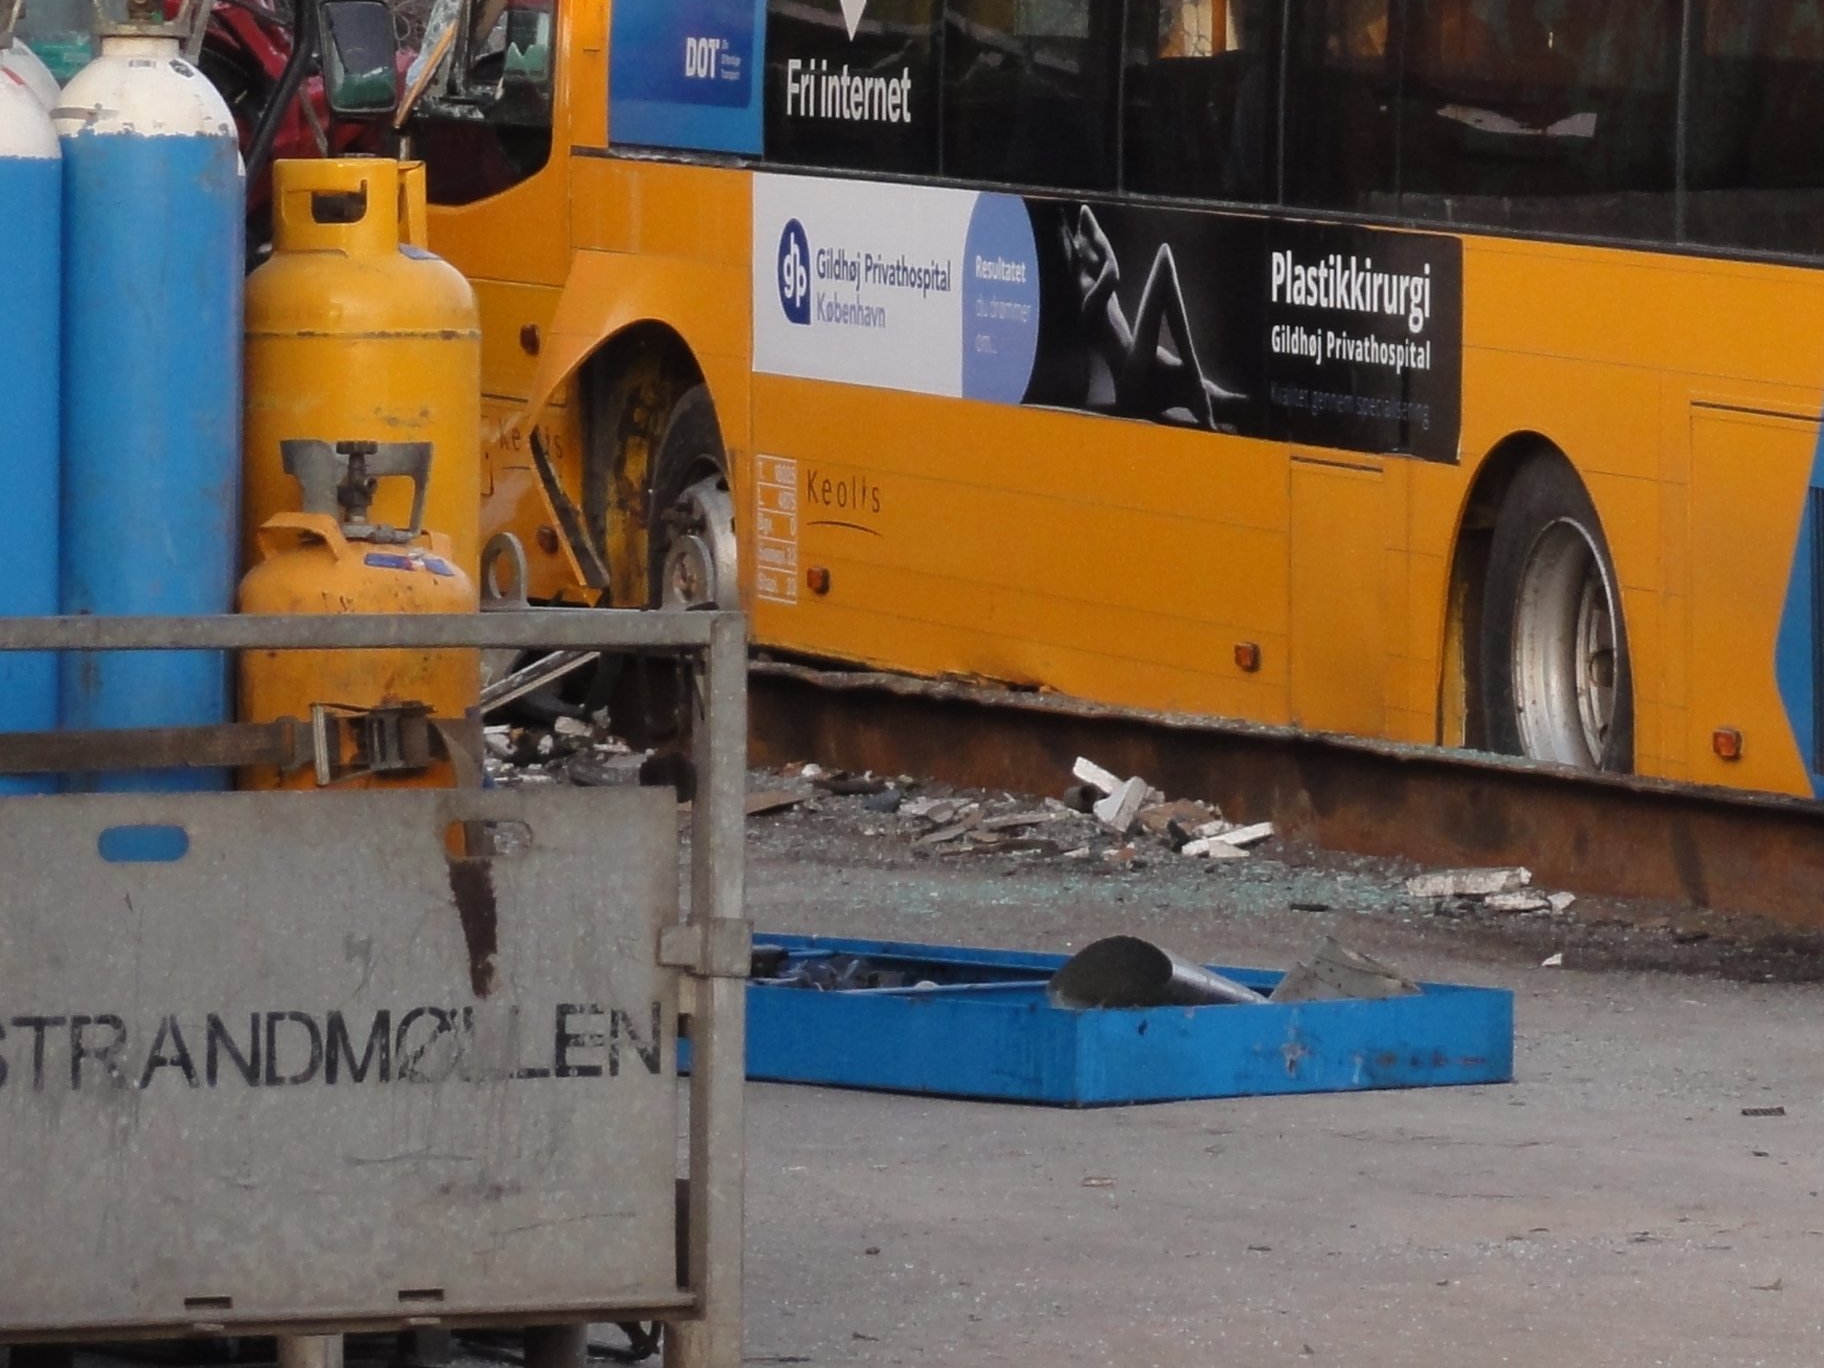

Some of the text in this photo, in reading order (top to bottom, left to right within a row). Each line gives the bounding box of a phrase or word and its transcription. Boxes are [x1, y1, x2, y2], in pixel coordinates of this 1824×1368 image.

[786, 58, 912, 123] Fri internet
[816, 247, 951, 299] Gildhøj Privathospital
[1271, 249, 1431, 332] Plastikkirurgi
[816, 291, 886, 329] København
[1271, 324, 1431, 375] Gildhøj Privathospital
[806, 468, 881, 514] Keolis
